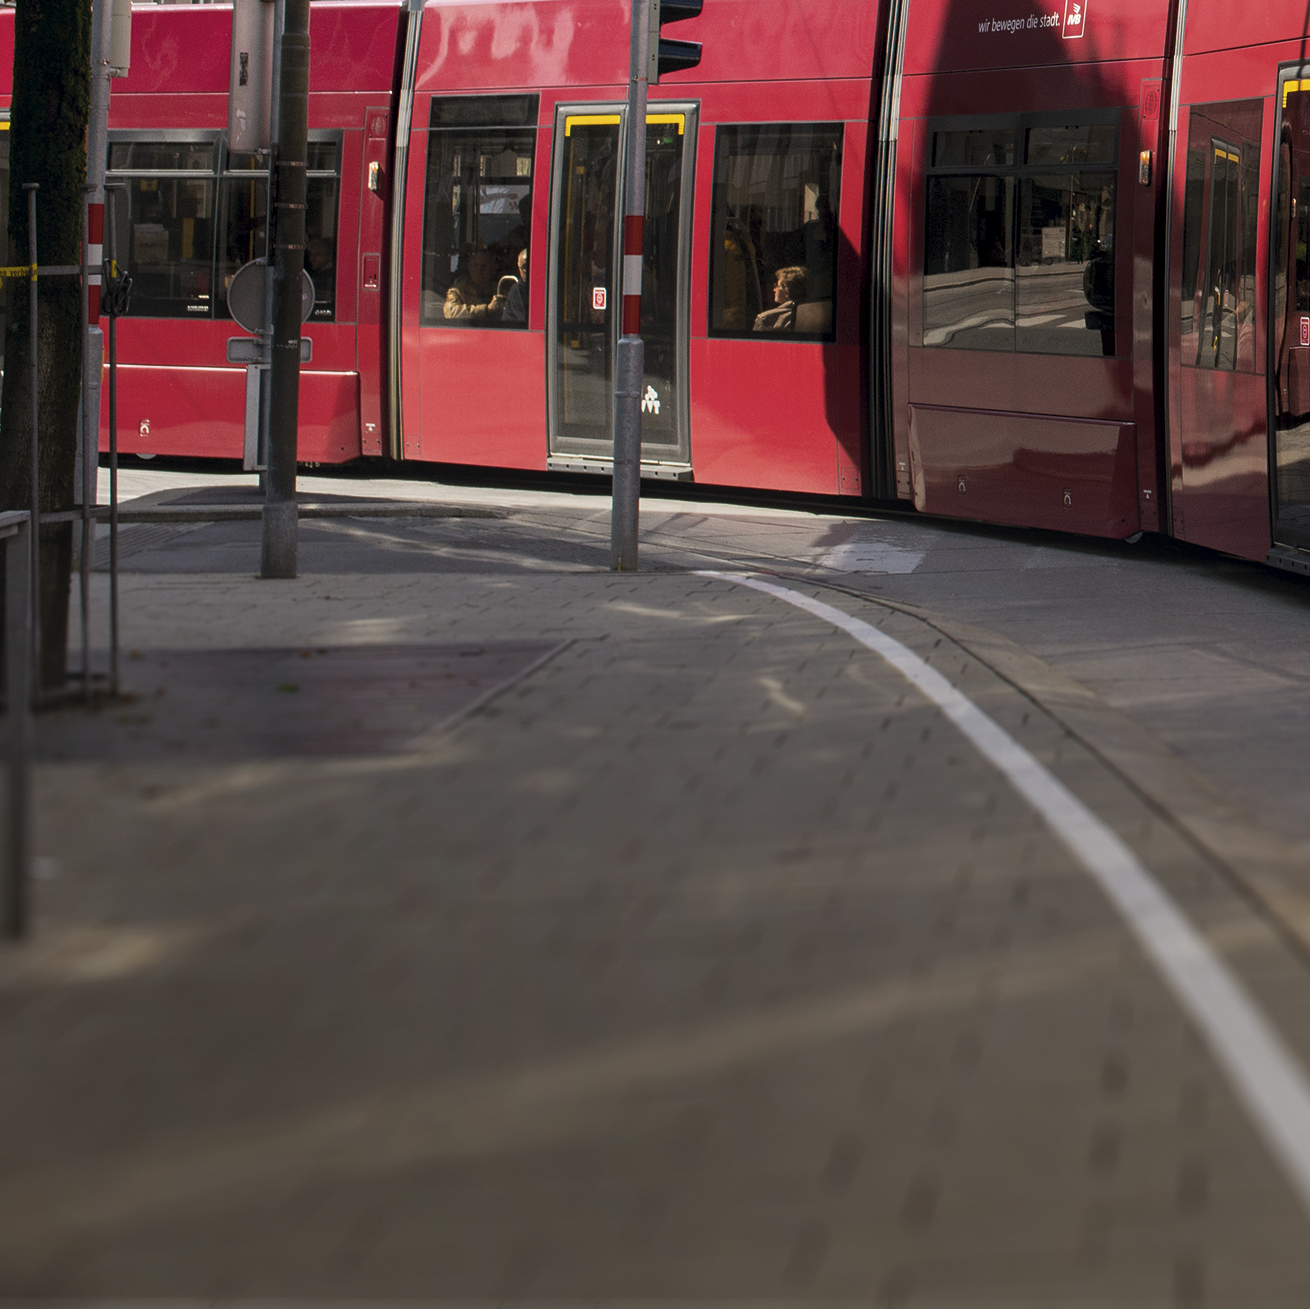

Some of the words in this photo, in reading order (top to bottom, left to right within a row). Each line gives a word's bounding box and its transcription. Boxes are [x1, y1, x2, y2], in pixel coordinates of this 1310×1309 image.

[978, 18, 990, 33] wir
[991, 17, 1025, 34] bewegen
[1026, 14, 1039, 29] die
[1039, 11, 1061, 28] stadt.
